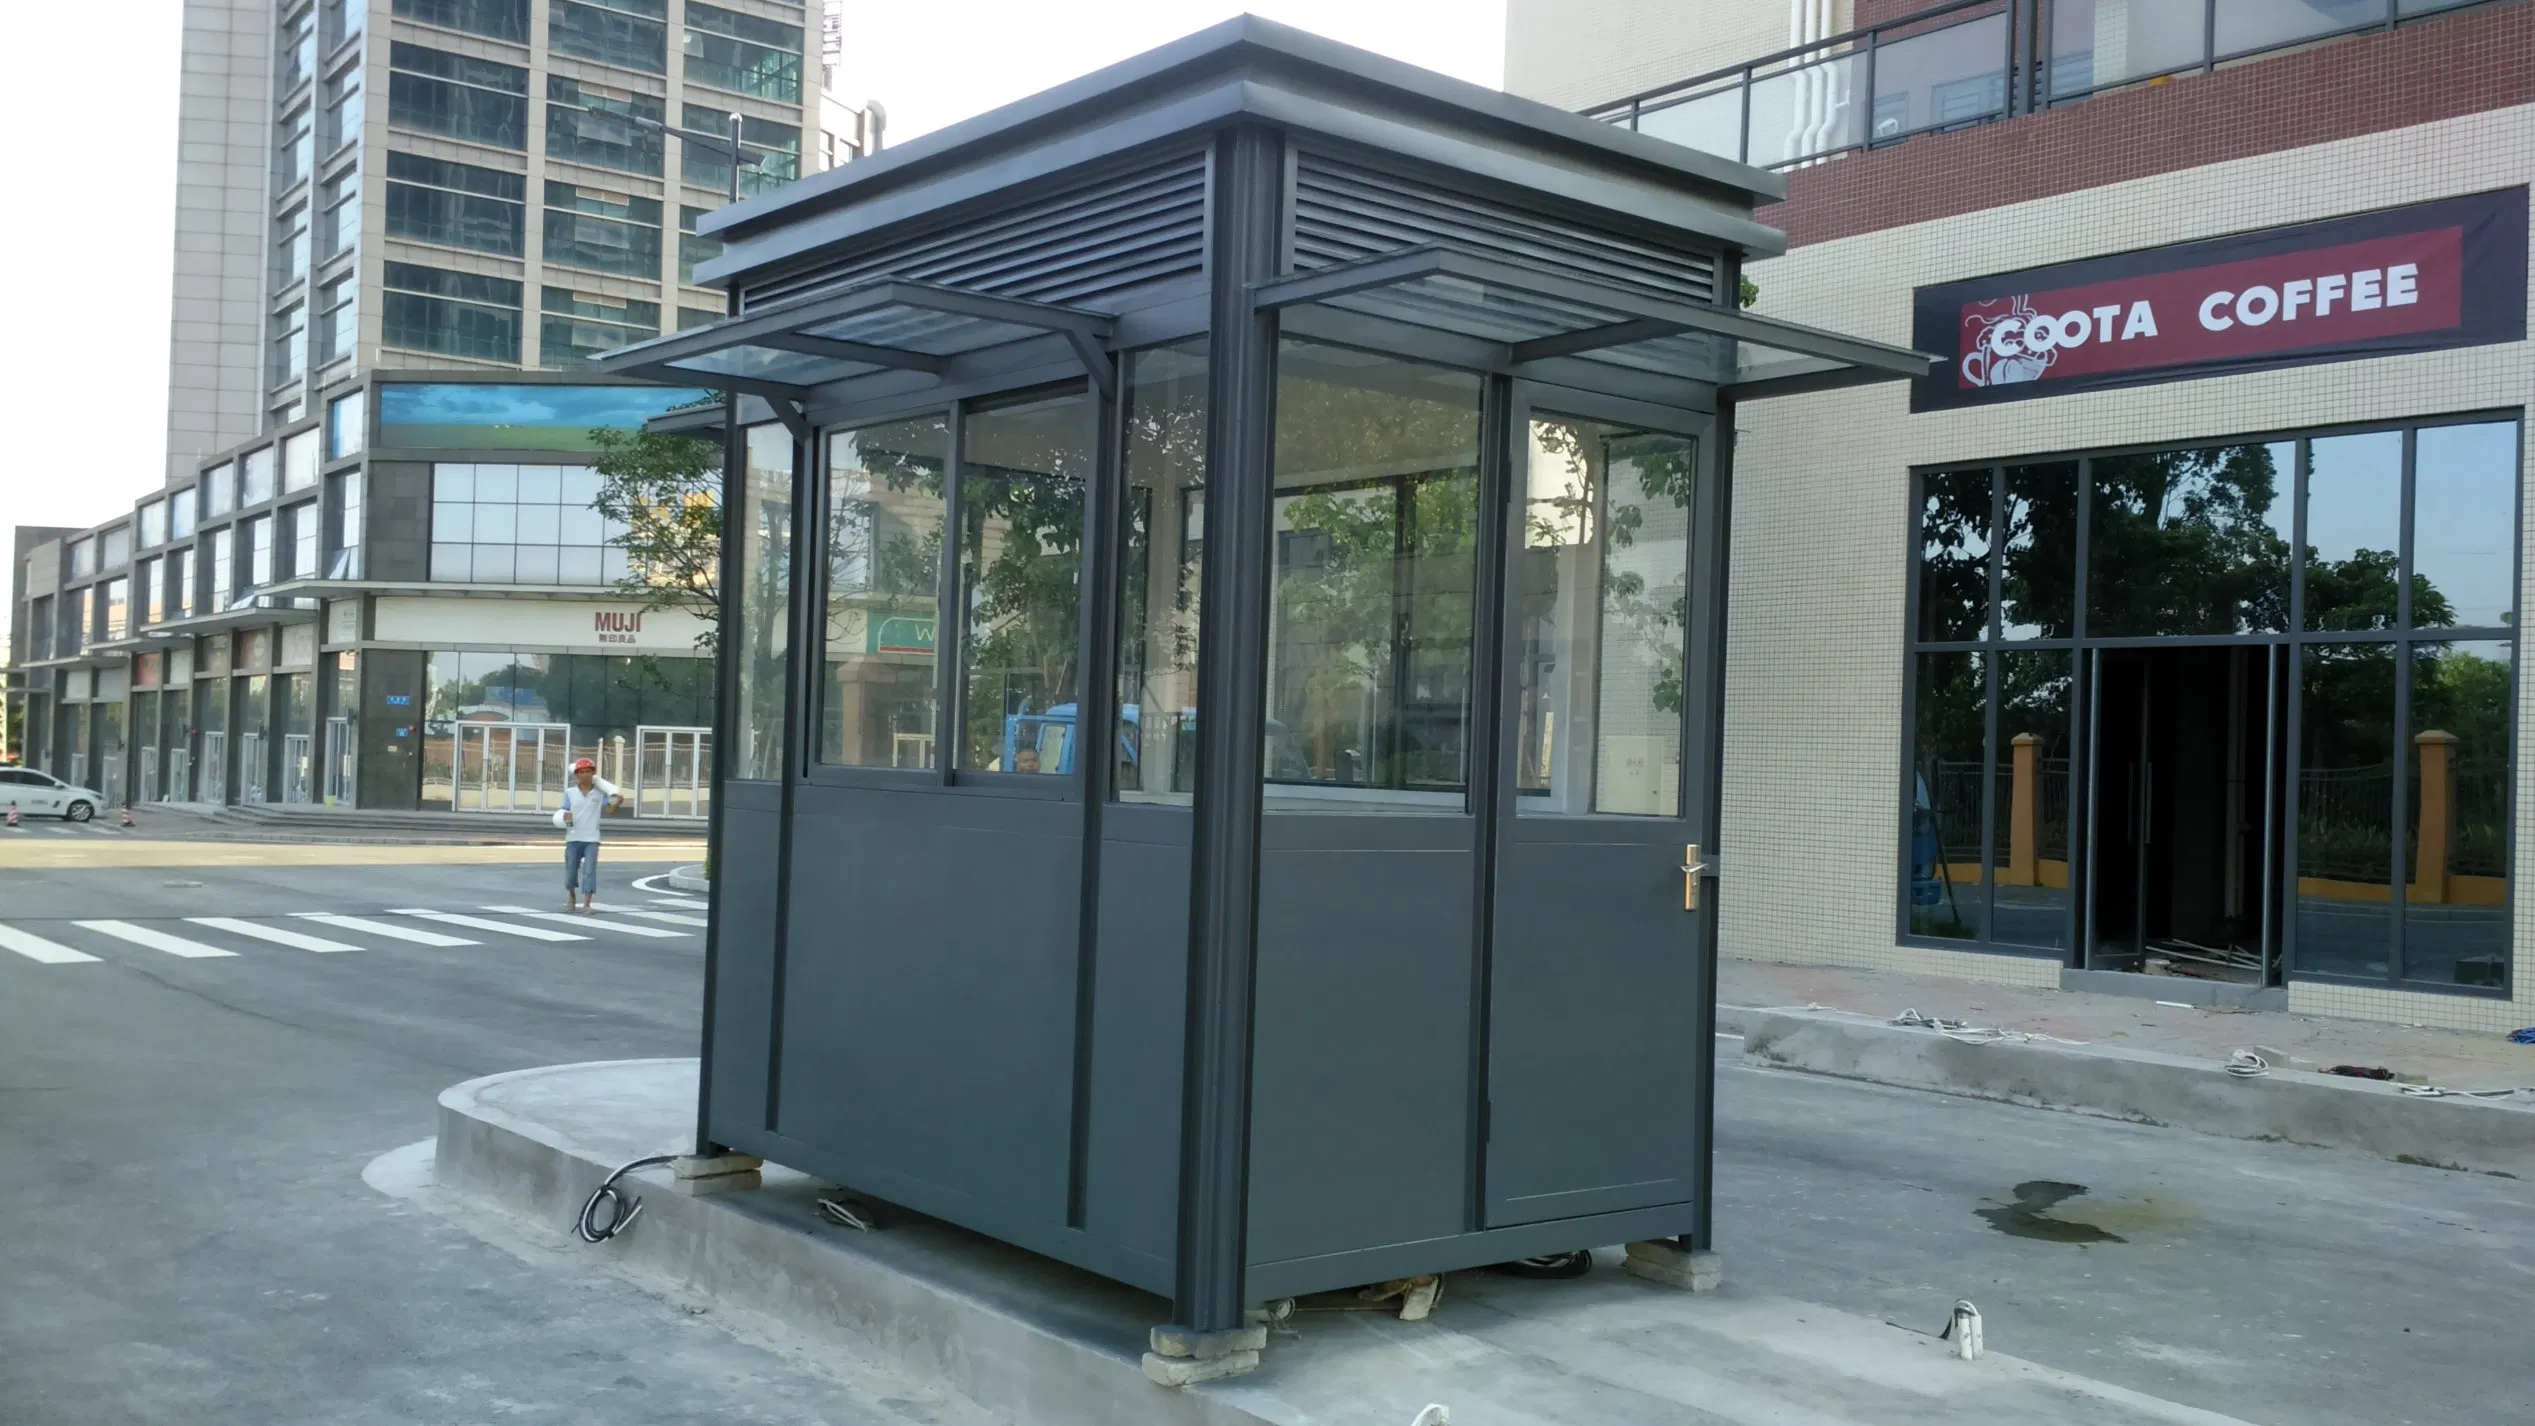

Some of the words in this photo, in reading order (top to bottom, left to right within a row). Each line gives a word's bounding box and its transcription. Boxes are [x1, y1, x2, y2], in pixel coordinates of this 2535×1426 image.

[1991, 300, 2158, 357] COOTA
[2198, 263, 2418, 331] COFFEE
[595, 612, 641, 632] MUJI
